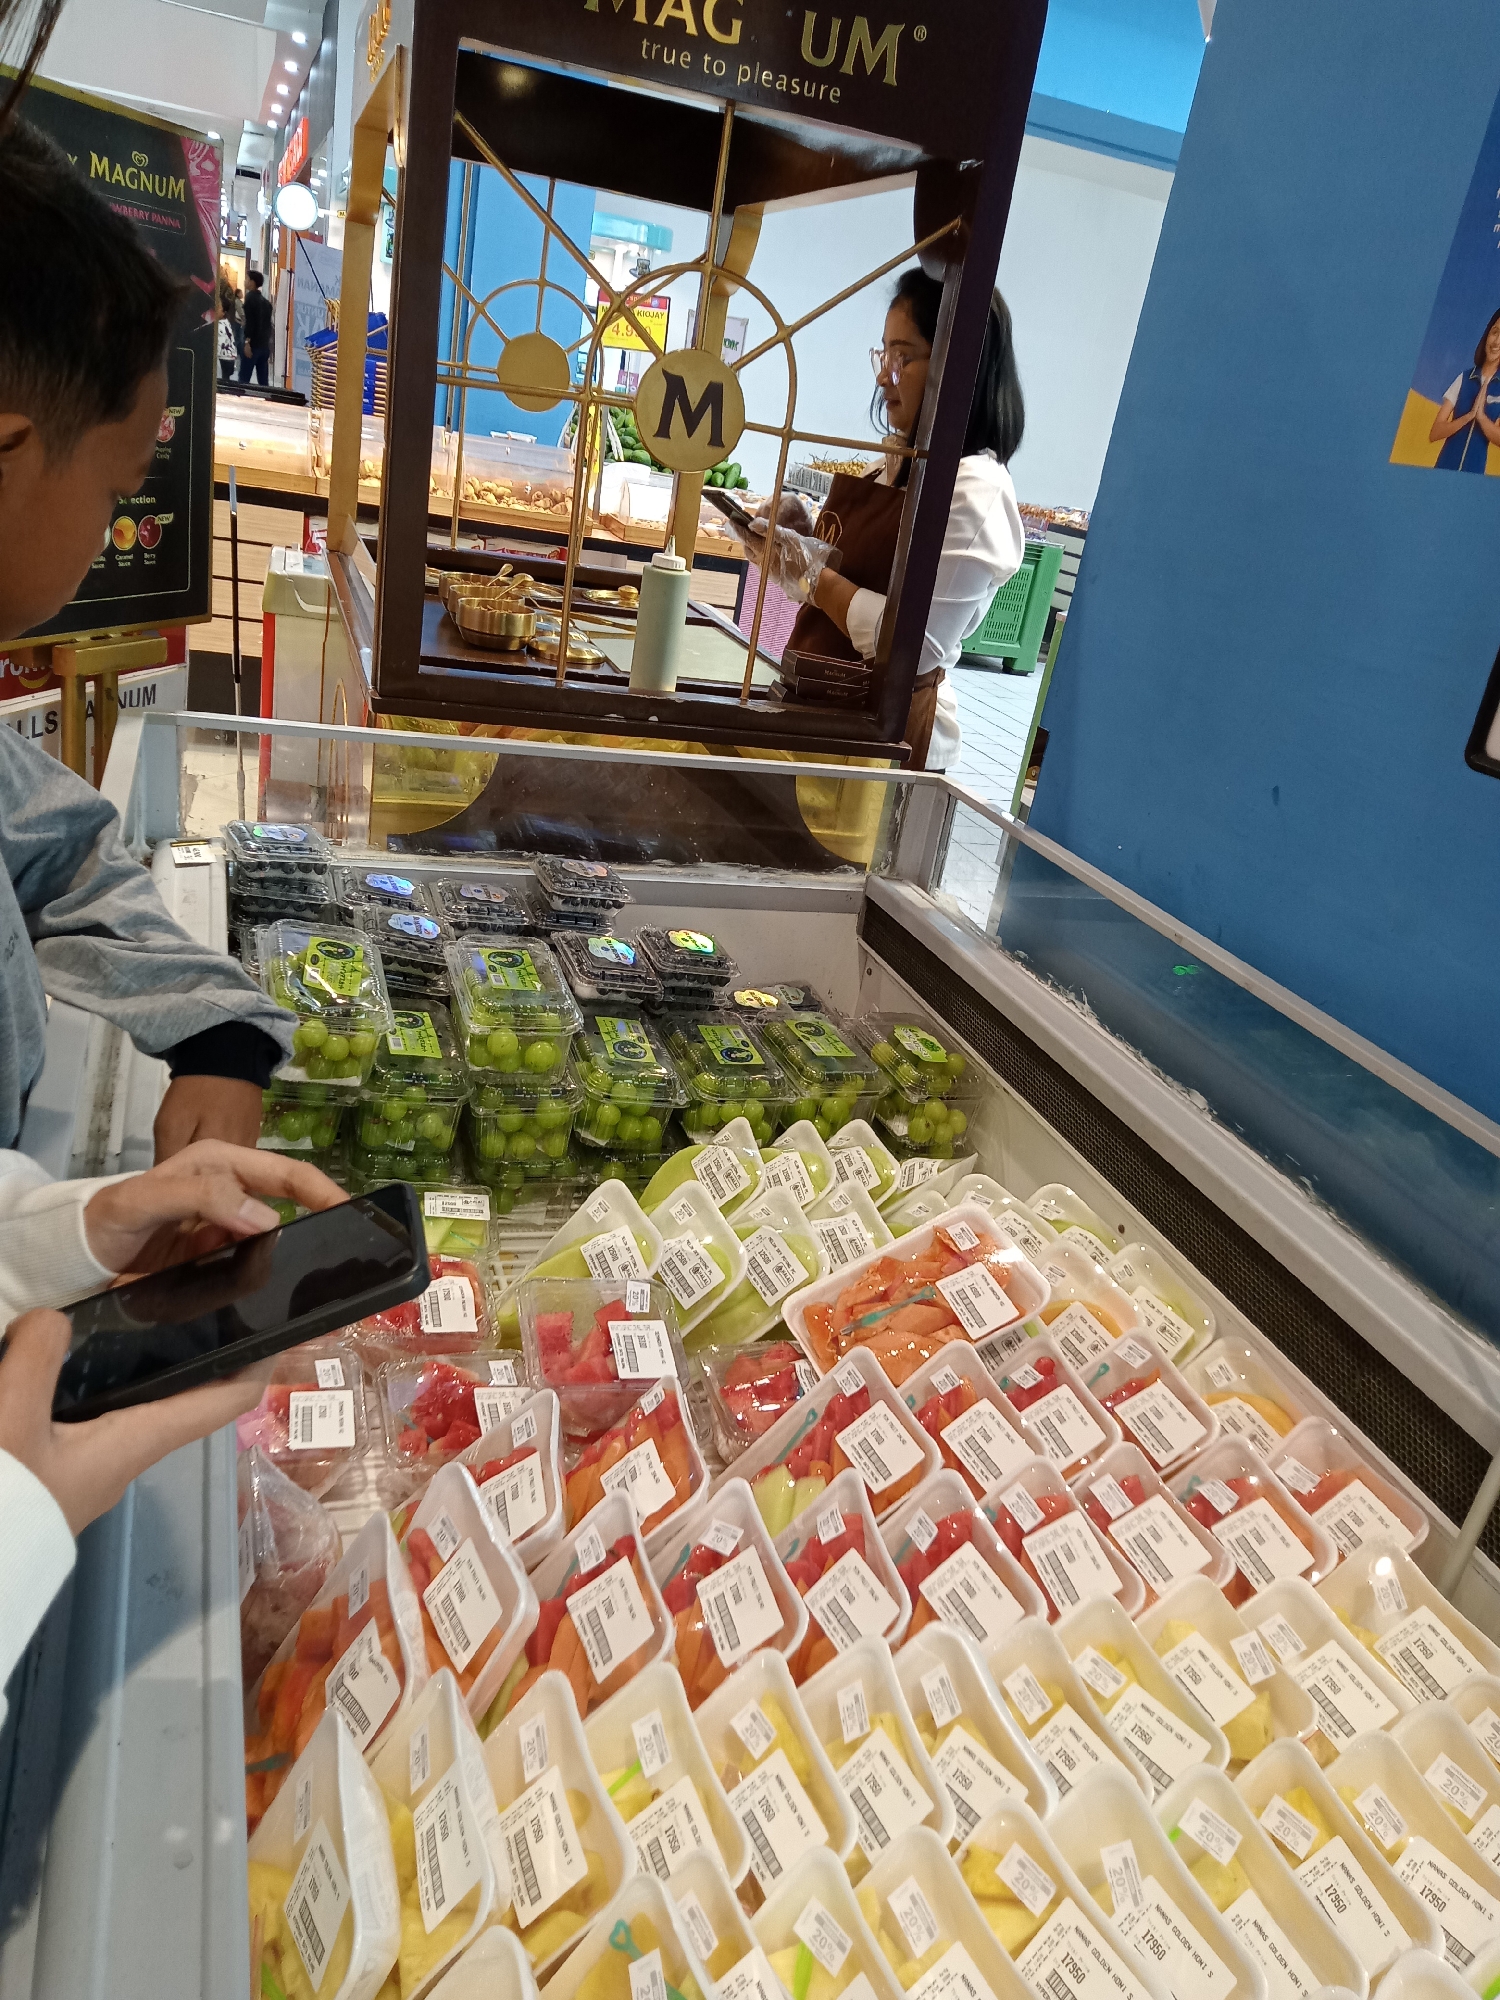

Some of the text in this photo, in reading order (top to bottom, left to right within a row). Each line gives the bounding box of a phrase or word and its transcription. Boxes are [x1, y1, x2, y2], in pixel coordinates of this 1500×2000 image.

[642, 38, 842, 104] true to pleasure
[89, 150, 186, 203] MAGNUM
[151, 211, 181, 229] PANNA
[634, 308, 665, 319] KIOJAY
[168, 408, 183, 416] NEW
[652, 367, 727, 449] M
[606, 1244, 619, 1261] 12500
[673, 1249, 688, 1266] 12500
[757, 1248, 772, 1265] 12500
[697, 1269, 711, 1285] HALAL
[780, 1269, 793, 1284] HALAL
[1412, 1636, 1434, 1660] 17950
[1182, 1663, 1203, 1686] 17950
[1320, 1673, 1342, 1696] 17950
[1129, 1722, 1154, 1746] 17950
[1054, 1745, 1078, 1770] 17950
[862, 1772, 883, 1797] 17950
[950, 1767, 974, 1791] 17950
[1442, 1776, 1473, 1808] 20%
[754, 1795, 777, 1823] 17950
[1367, 1807, 1392, 1837] 20%
[435, 1810, 452, 1840] 17950
[527, 1814, 546, 1842] 17950
[662, 1825, 682, 1853] 17950
[1195, 1822, 1228, 1855] 20%
[1274, 1817, 1305, 1849] 20%
[1012, 1870, 1043, 1903] 20%
[1108, 1865, 1130, 1903] 20%
[1322, 1884, 1348, 1914] 17950
[1338, 1862, 1355, 1884] NANAS
[1353, 1884, 1373, 1910] GOLDEN
[1370, 1910, 1385, 1928] HONI
[1418, 1884, 1447, 1913] 17950
[1426, 1859, 1448, 1879] NANAS
[1447, 1877, 1472, 1900] GOLDEN
[1471, 1898, 1488, 1914] HONI
[899, 1906, 927, 1942] 20%
[1153, 1903, 1174, 1926] NANAS
[1170, 1925, 1193, 1951] GOLDEN
[1191, 1951, 1209, 1971] HONI
[809, 1927, 839, 1962] 20%
[1072, 1925, 1092, 1947] NANAS
[1090, 1947, 1113, 1974] GOLDEN
[1110, 1973, 1128, 1993] HONI
[1139, 1929, 1168, 1961] 17950
[1251, 1919, 1269, 1941] NANAS
[1267, 1942, 1289, 1970] GOLDEN
[1286, 1969, 1303, 1989] HONI
[1058, 1951, 1088, 1985] 17950
